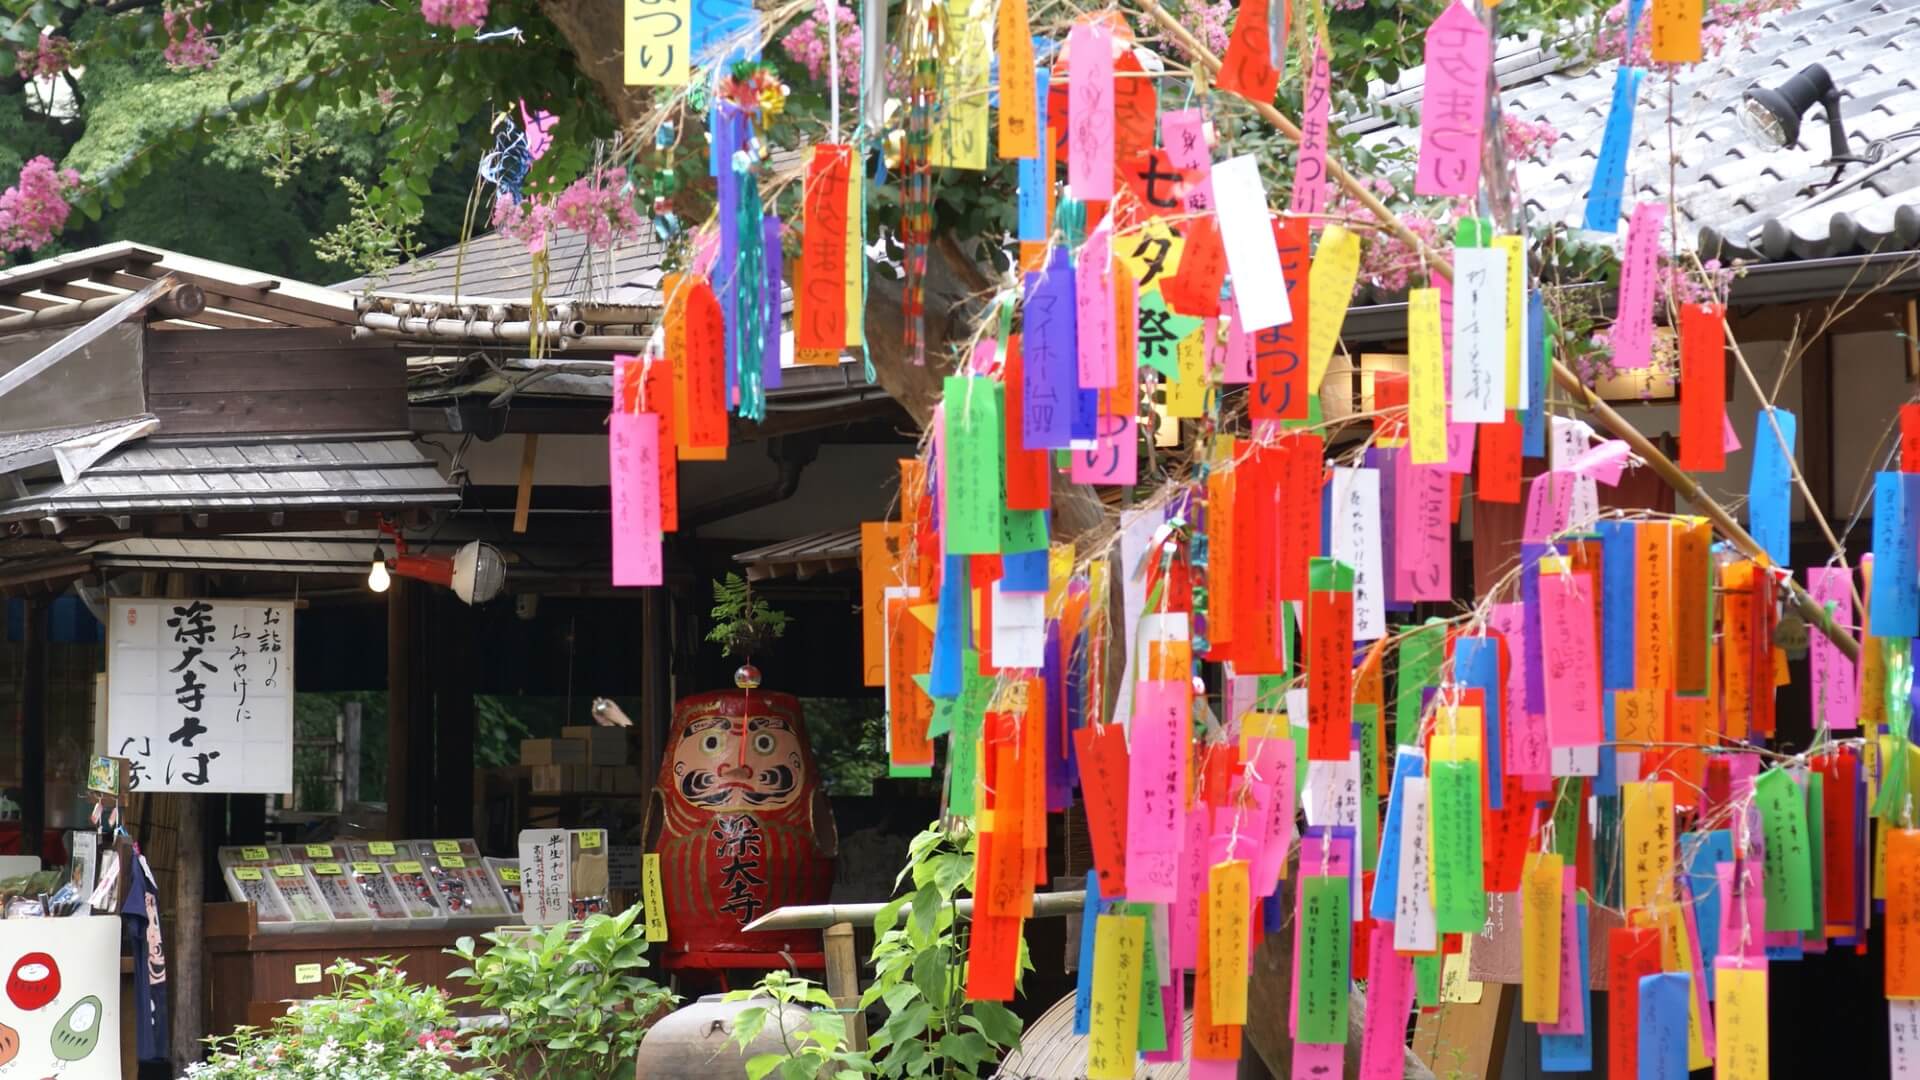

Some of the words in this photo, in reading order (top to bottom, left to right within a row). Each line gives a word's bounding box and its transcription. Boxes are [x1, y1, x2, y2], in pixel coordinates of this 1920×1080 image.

[632, 0, 683, 77] つり
[712, 814, 768, 924] 深大寺
